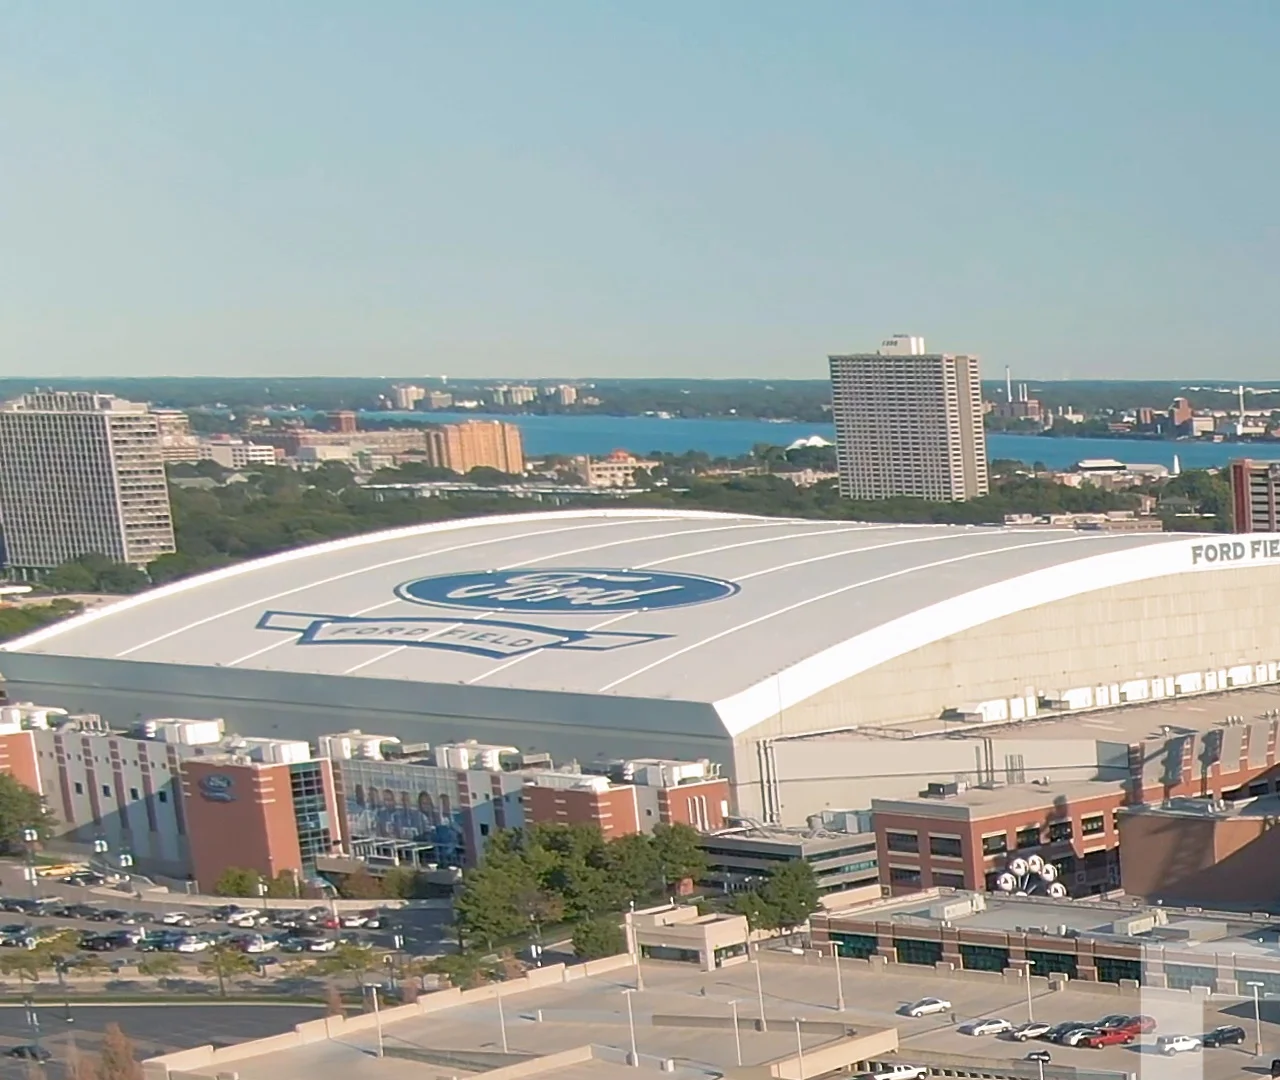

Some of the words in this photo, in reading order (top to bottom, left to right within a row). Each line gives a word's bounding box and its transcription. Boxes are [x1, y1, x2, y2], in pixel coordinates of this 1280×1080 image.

[1191, 542, 1246, 565] FORD
[446, 572, 686, 606] Ford
[330, 626, 430, 638] FORD
[442, 630, 534, 647] FIELD
